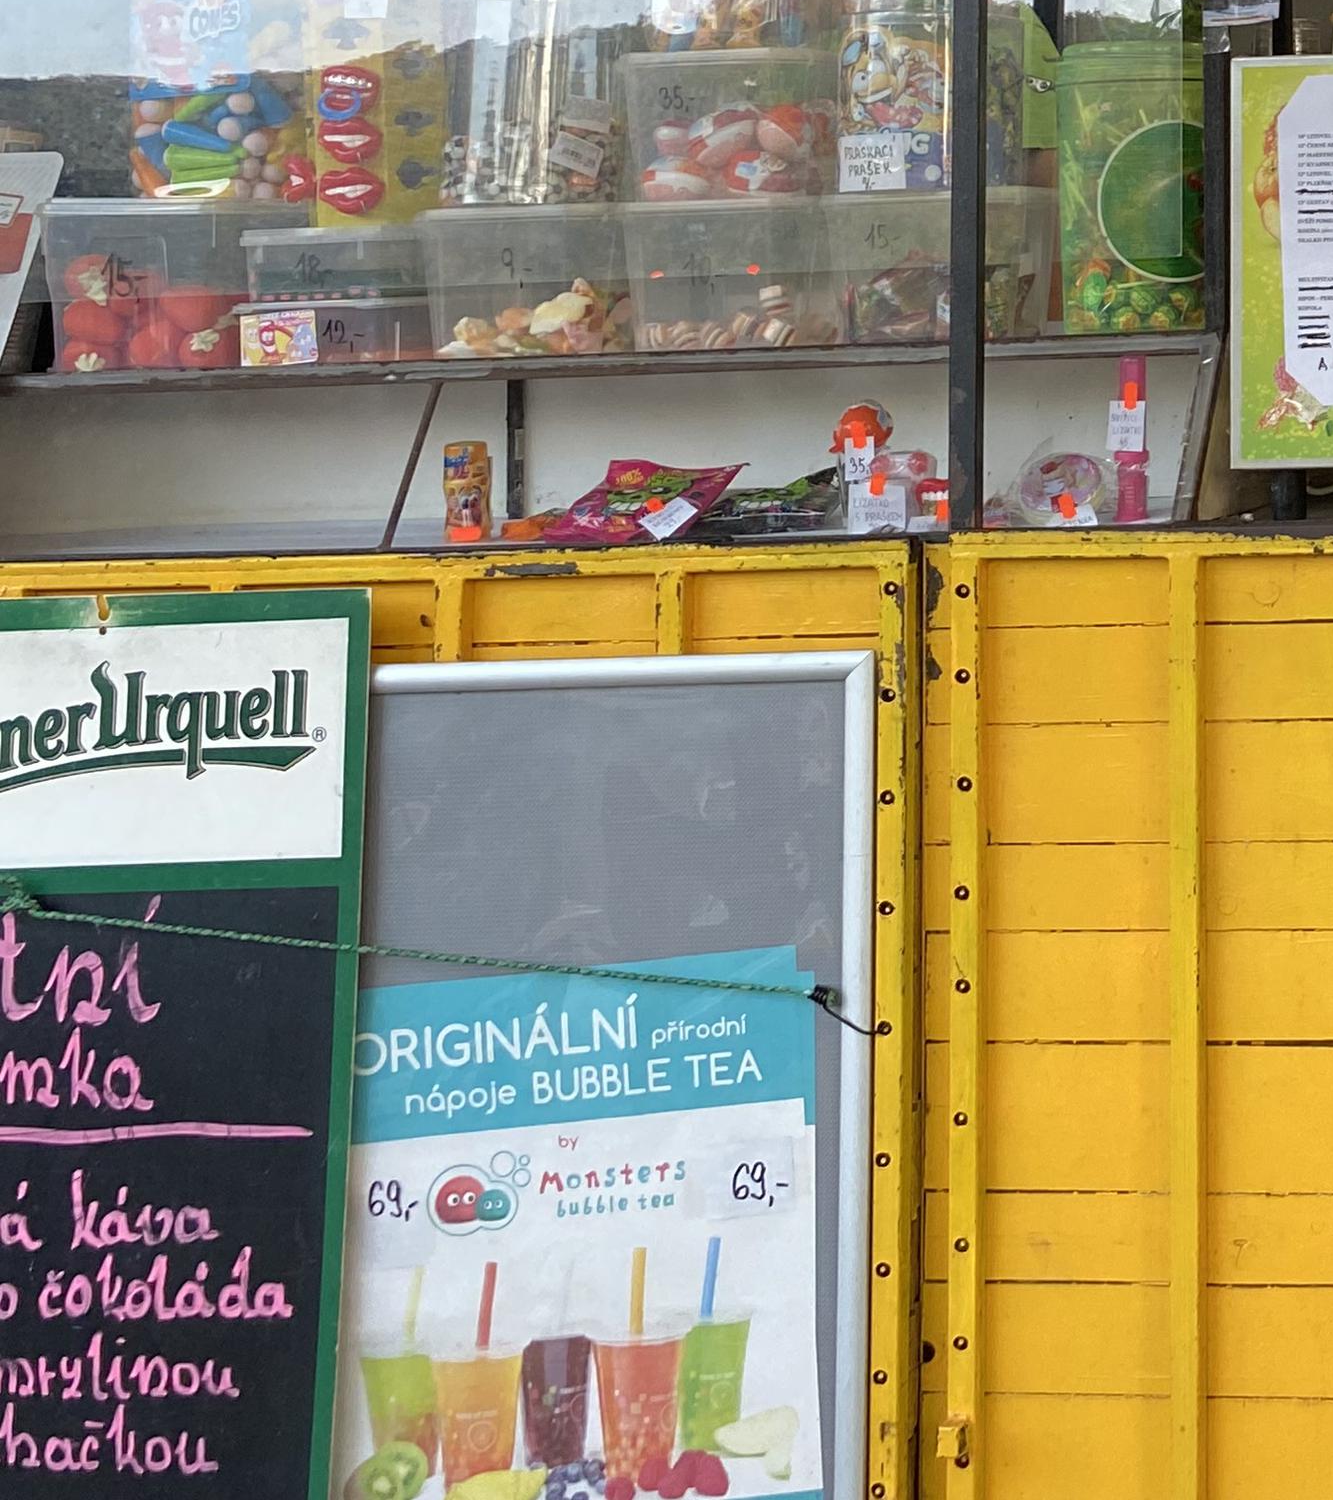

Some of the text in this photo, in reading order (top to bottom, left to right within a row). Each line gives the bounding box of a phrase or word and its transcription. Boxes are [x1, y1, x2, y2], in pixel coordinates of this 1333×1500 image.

[1317, 357, 1328, 371] A
[90, 659, 311, 781] Urquell
[352, 992, 748, 1078] ORIGINÁLNÍ přírodní
[403, 1049, 764, 1120] nápoje BUBBLE TEA
[556, 1133, 580, 1152] by
[539, 1157, 688, 1195] Monsters
[555, 1191, 678, 1220] bubble tea
[730, 1160, 791, 1208] 69,-
[69, 1167, 224, 1252] káva
[36, 1244, 296, 1323] čokoláda
